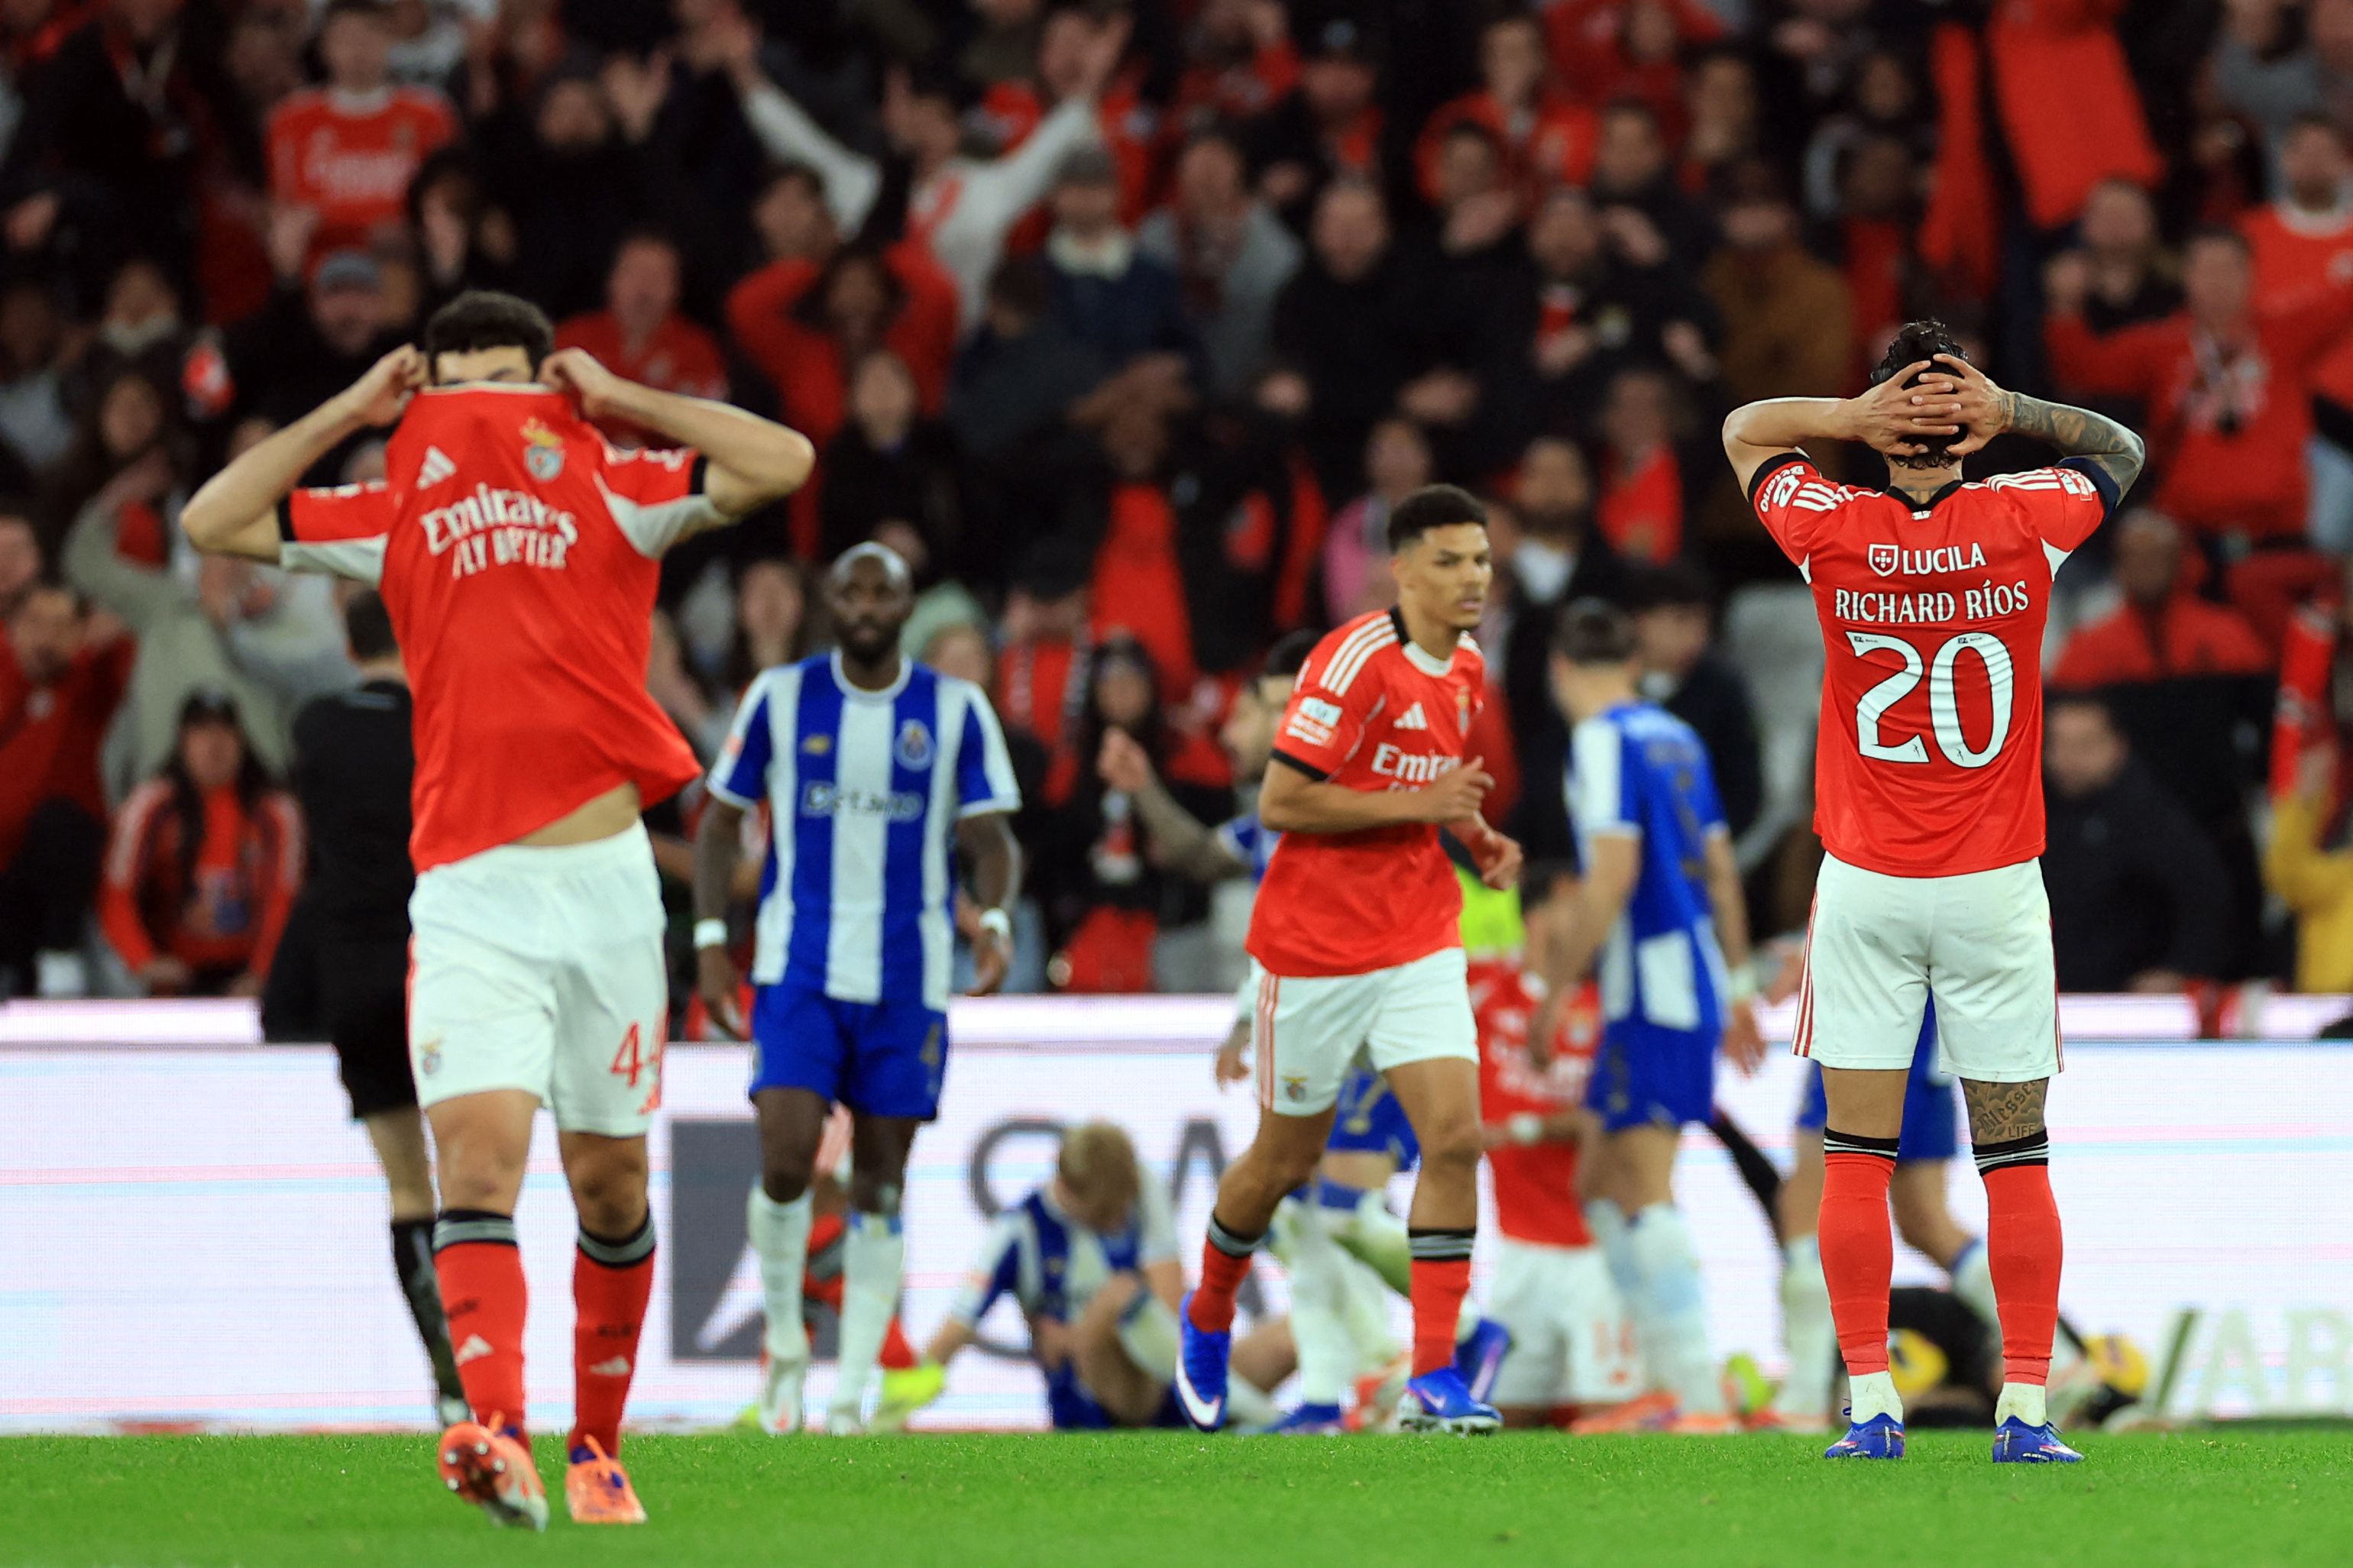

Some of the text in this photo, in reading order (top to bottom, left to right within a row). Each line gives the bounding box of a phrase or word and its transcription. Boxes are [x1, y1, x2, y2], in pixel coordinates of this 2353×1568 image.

[1902, 542, 1987, 575] LUCILA
[1835, 578, 2030, 624] RICHARD RÍOS
[1844, 630, 2015, 769] 20
